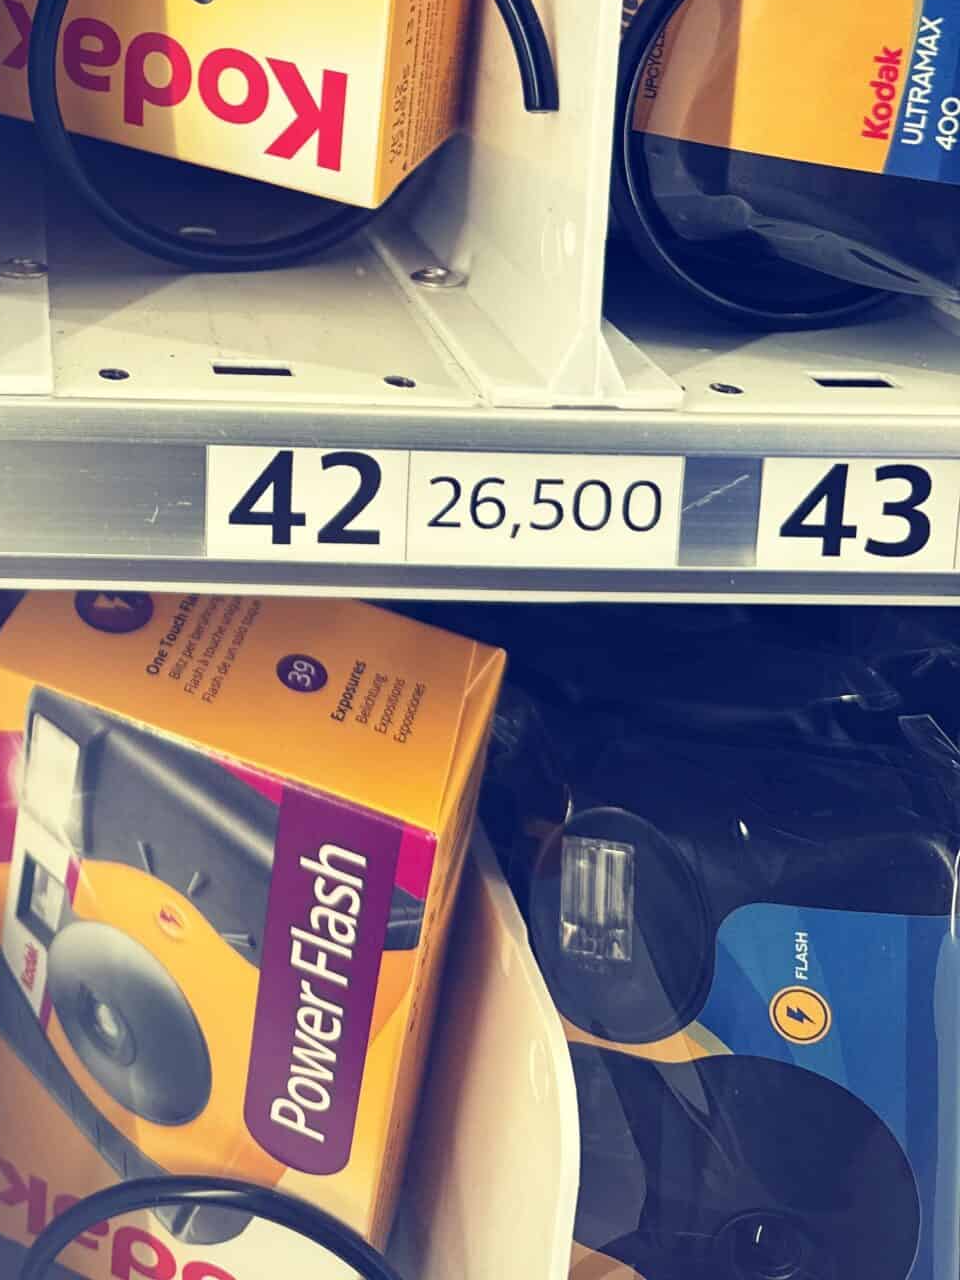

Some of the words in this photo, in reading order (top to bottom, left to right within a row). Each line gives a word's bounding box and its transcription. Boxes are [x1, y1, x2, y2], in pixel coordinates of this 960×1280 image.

[861, 46, 903, 142] Kodak
[901, 16, 943, 145] ULTRAMAX
[936, 97, 960, 151] 400
[227, 450, 381, 545] 42
[427, 475, 662, 539] 26,500
[778, 463, 933, 558] 43
[145, 649, 167, 676] One
[160, 613, 189, 647] Touch
[288, 660, 315, 688] 39
[330, 660, 366, 722] Exposures
[291, 844, 367, 986] Flash
[794, 930, 809, 980] FLASH
[270, 979, 342, 1143] Power
